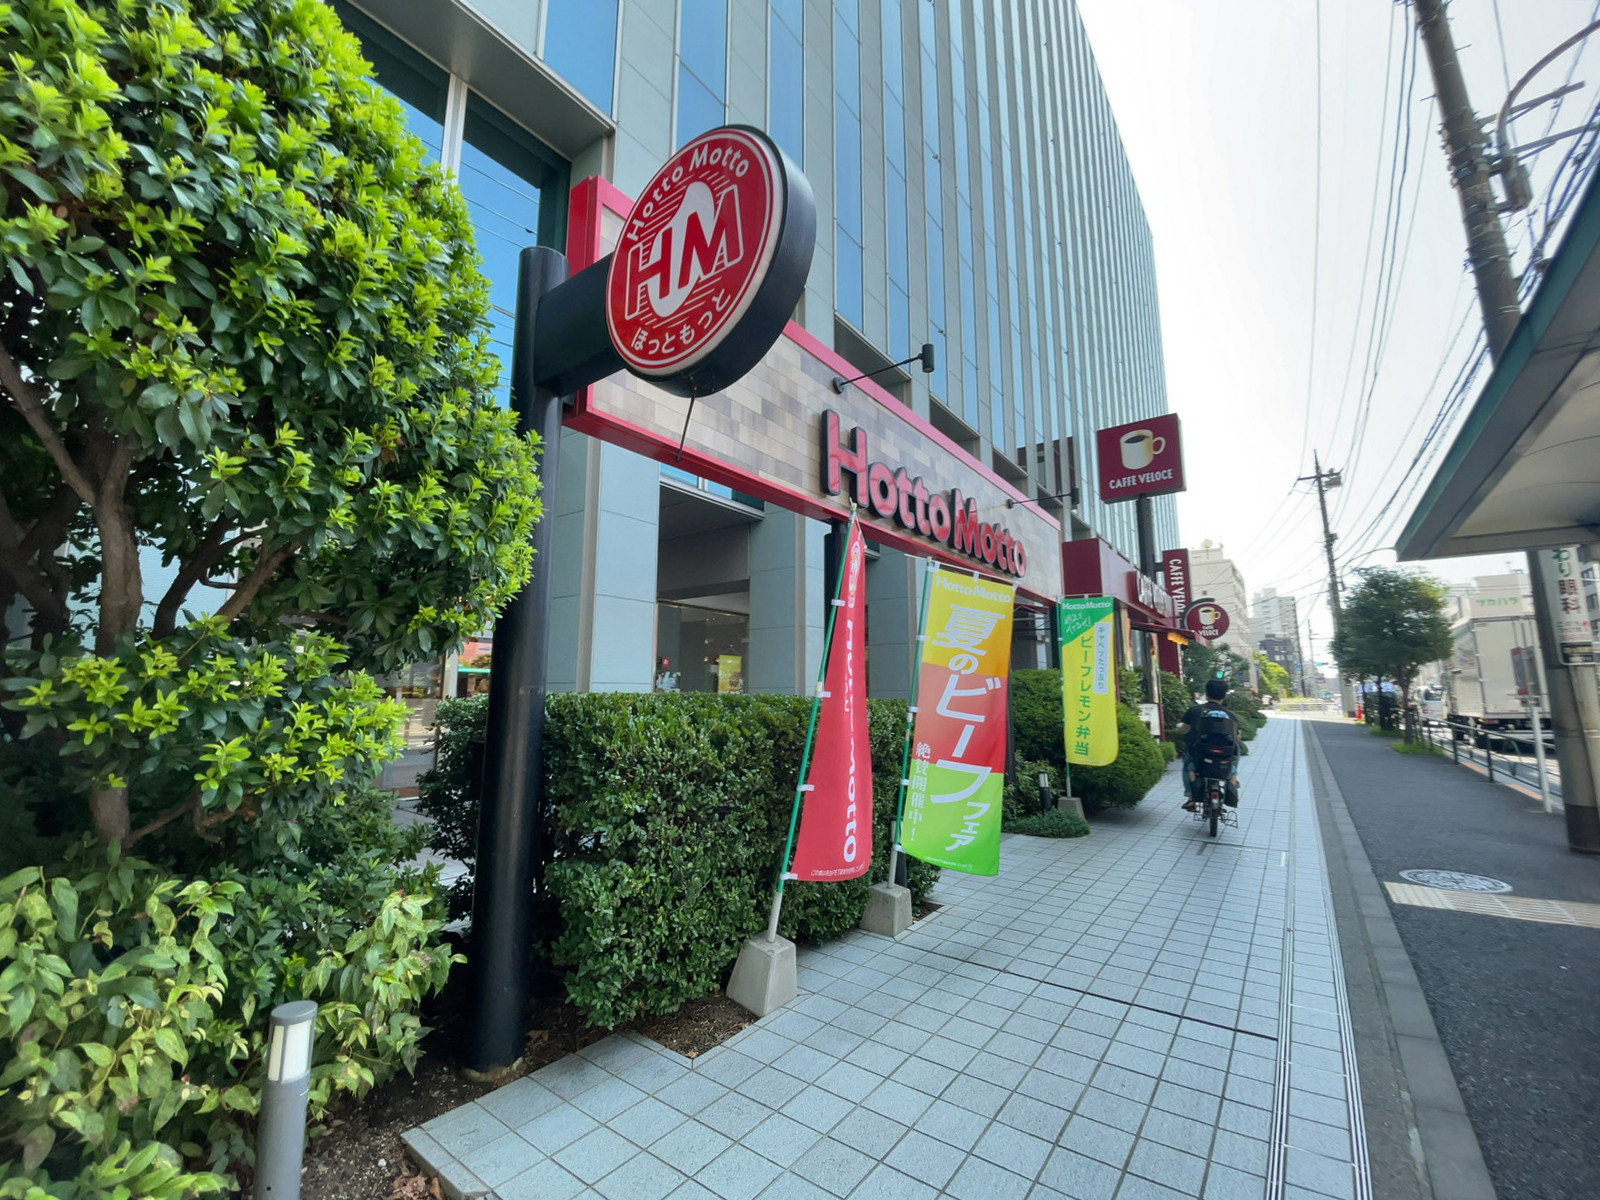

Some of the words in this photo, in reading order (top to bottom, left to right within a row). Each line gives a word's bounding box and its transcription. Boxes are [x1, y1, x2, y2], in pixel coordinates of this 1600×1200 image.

[627, 166, 683, 242] Hotto
[689, 143, 750, 177] Motto
[631, 288, 732, 354] ほっともっと
[1109, 475, 1137, 490] CAFFE
[1138, 468, 1173, 484] VELOCE
[1169, 559, 1184, 586] CAFFE
[1074, 635, 1092, 756] ビーフレモン弁当
